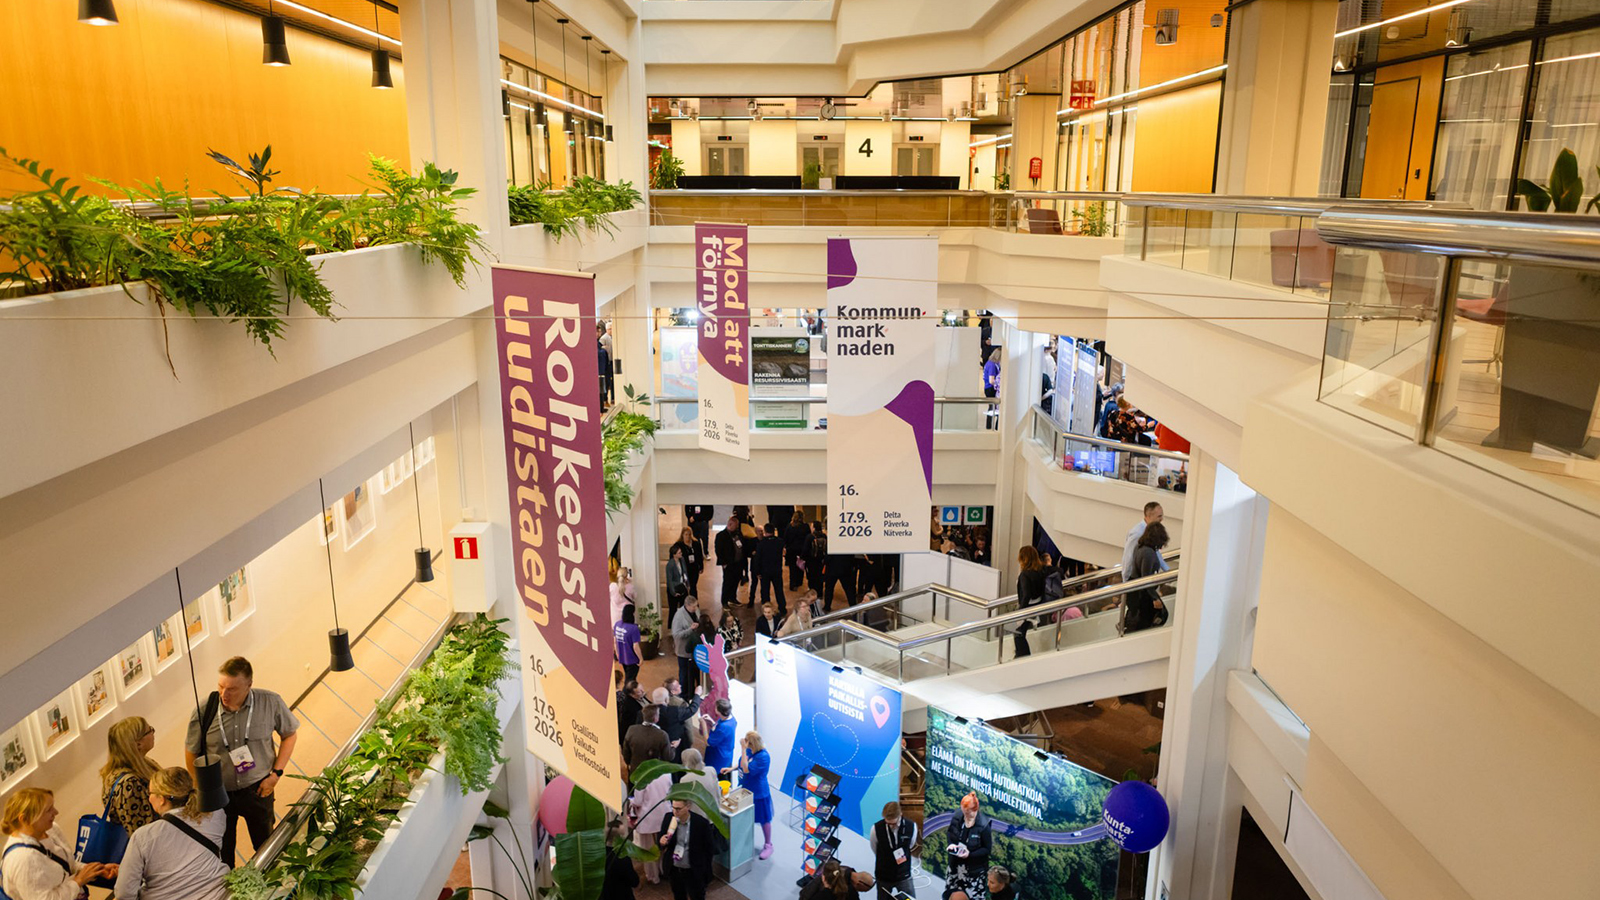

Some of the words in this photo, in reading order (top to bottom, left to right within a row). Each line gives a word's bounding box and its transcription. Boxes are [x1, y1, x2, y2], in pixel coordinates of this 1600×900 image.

[858, 138, 873, 158] 4
[723, 237, 745, 310] Mod
[698, 234, 722, 339] förnya
[724, 320, 744, 367] att
[837, 340, 894, 356] naden
[704, 398, 714, 408] 16.
[704, 419, 718, 430] 17.9.
[704, 429, 720, 440] 2026
[504, 295, 549, 626] uudistaen
[542, 300, 598, 652] Rohkeasti
[839, 484, 859, 496] 16.
[839, 512, 868, 523] 17.9.
[884, 520, 909, 528] Påverka
[838, 525, 872, 537] 2026
[530, 654, 547, 678] 16.
[828, 686, 868, 710] PAIKALLIS-
[828, 698, 864, 722] UUTISISTA
[533, 696, 559, 725] 17.9.
[534, 716, 564, 748] 2026
[572, 719, 599, 744] Osallistu
[572, 732, 596, 756] Vaikuta
[573, 746, 610, 779] Verkostoidu
[931, 745, 953, 764] ELÄMÄ
[954, 756, 964, 769] ON
[965, 759, 992, 781] TÄYNNÄ
[993, 772, 1045, 805] AUTOMATKOJA.
[931, 760, 941, 774] ME
[942, 764, 969, 786] TEEMME
[970, 776, 992, 797] NIISTÄ
[993, 788, 1044, 821] HUOLETTOMIA.
